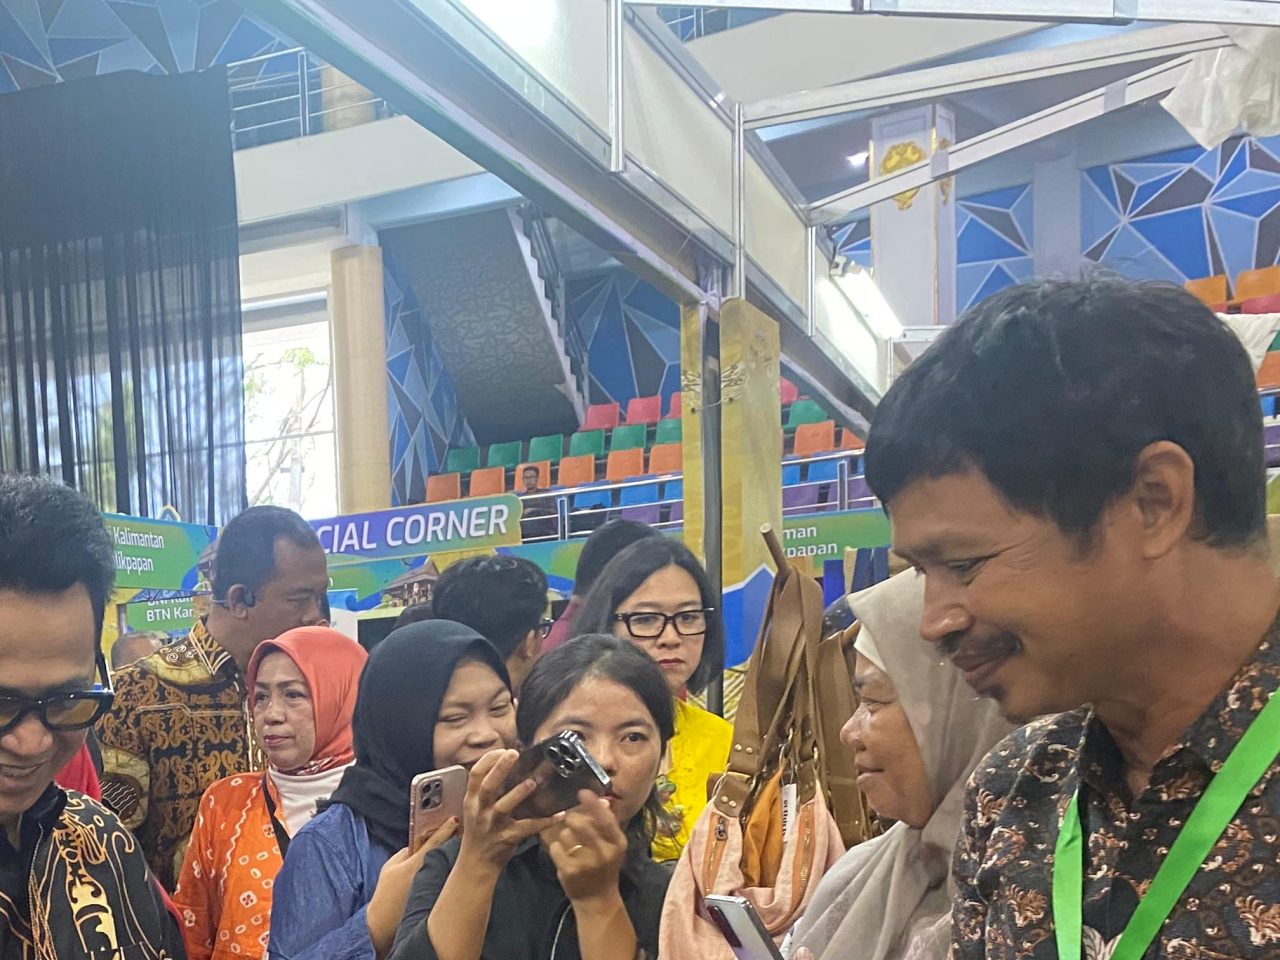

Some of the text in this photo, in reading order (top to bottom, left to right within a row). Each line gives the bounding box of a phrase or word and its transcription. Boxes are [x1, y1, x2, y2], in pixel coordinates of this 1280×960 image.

[385, 503, 509, 548] CORNER
[112, 526, 165, 549] Kalimantan
[146, 607, 171, 622] BTN
